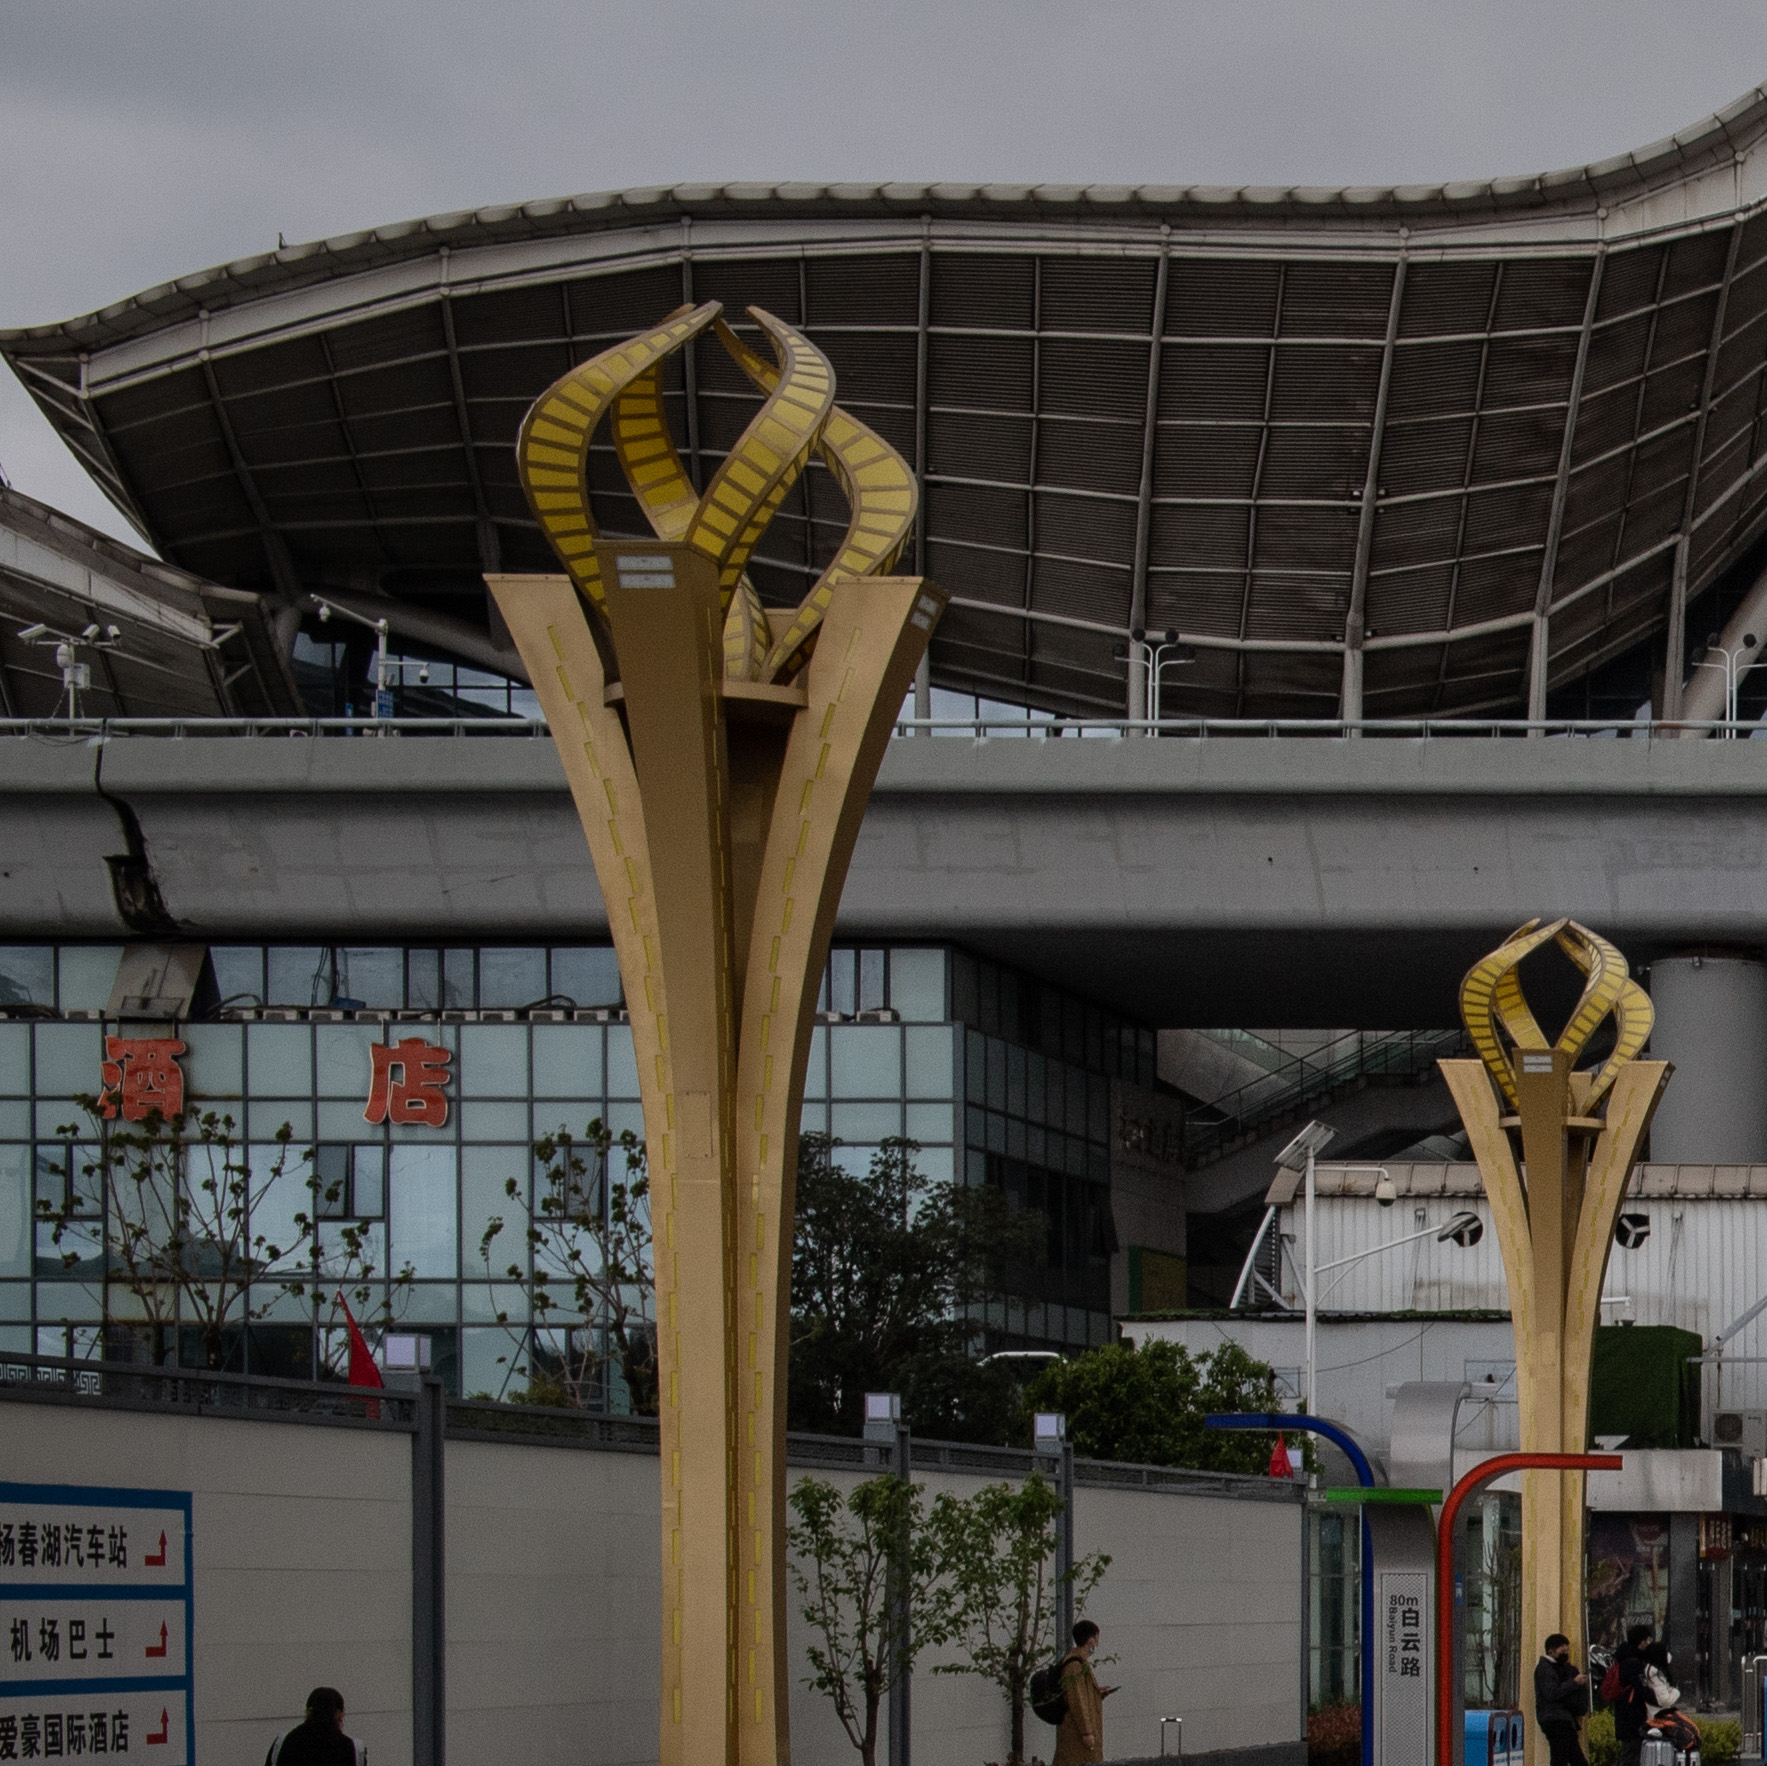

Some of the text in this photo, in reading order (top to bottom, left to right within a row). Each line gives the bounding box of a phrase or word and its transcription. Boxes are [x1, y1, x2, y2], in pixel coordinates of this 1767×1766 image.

[98, 1036, 454, 1127] 酒店
[1389, 1594, 1419, 1606] 80m
[10, 1617, 115, 1662] 机场巴士
[1387, 1606, 1398, 1674] Baiyun Road
[1400, 1607, 1421, 1677] 白云路
